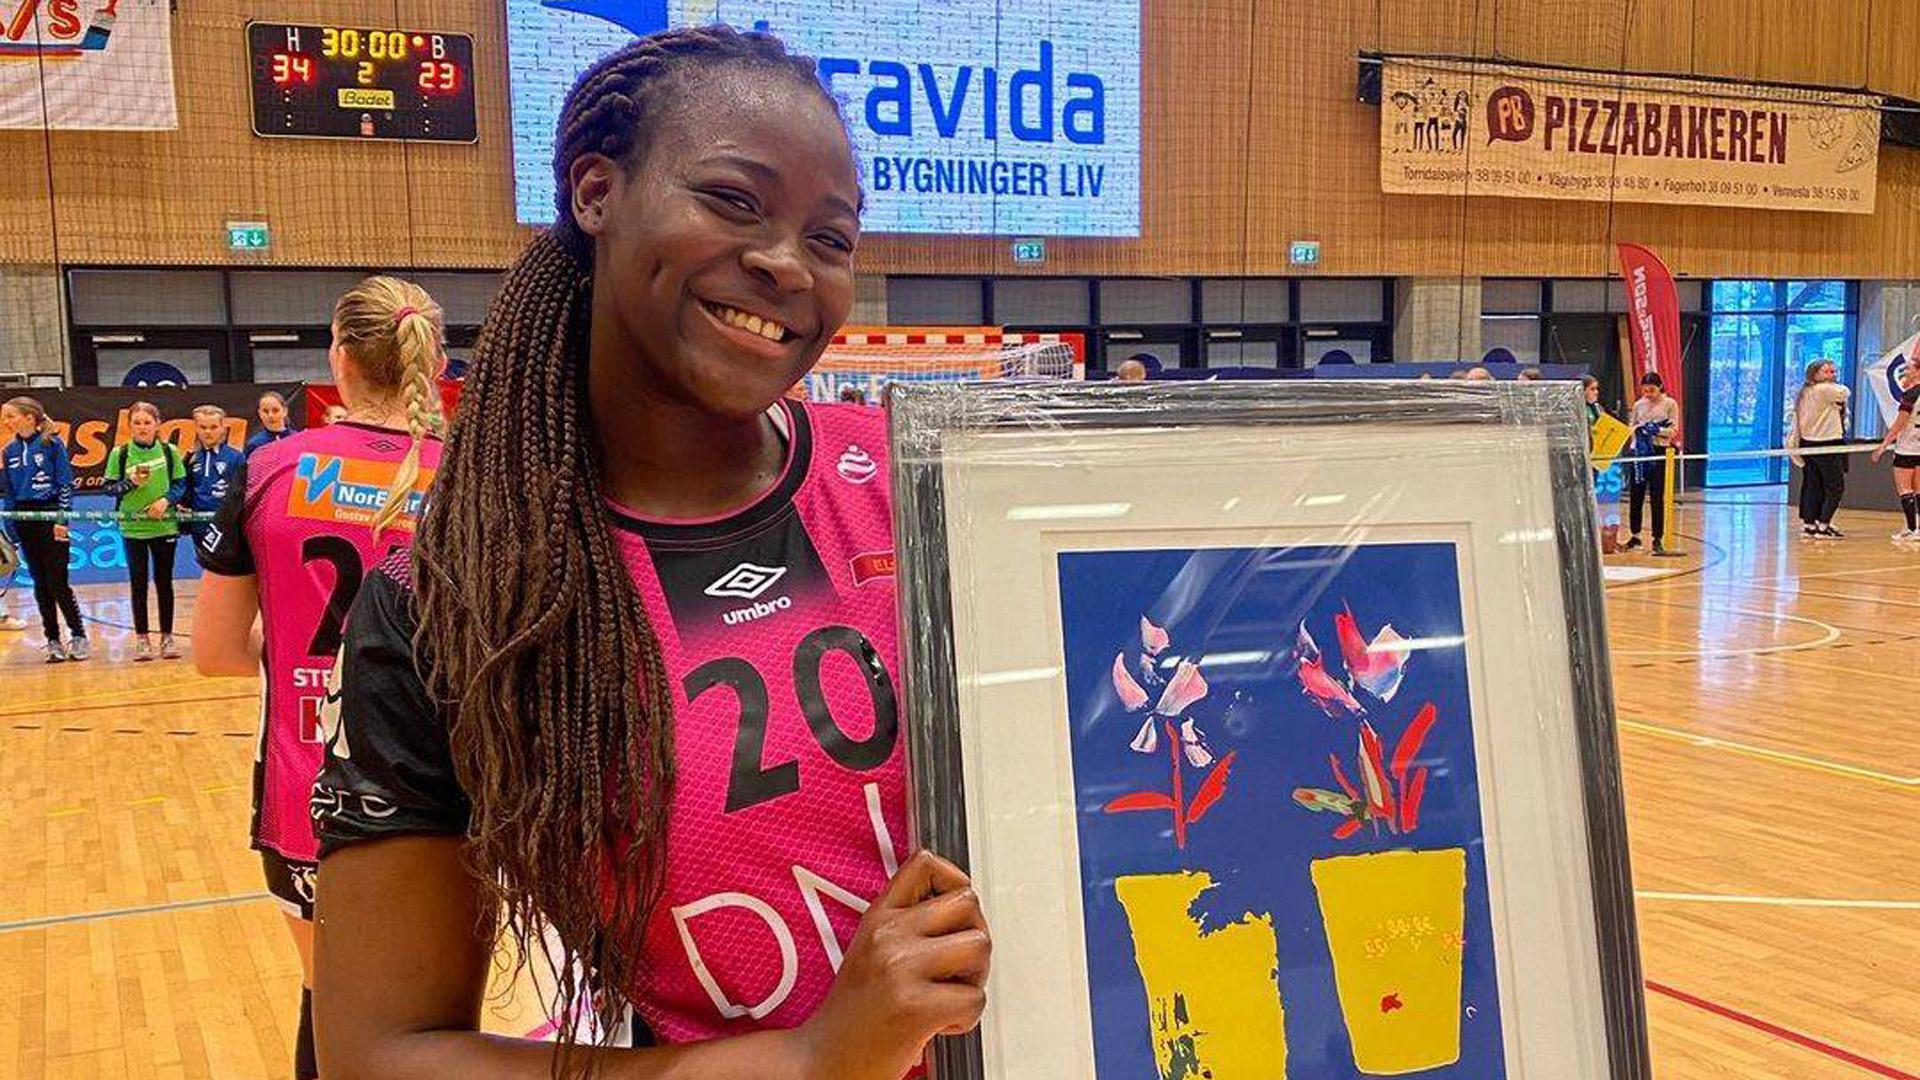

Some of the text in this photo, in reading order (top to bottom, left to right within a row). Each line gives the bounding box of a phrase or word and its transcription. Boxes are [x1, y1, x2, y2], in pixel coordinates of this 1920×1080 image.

[286, 27, 301, 52] H
[322, 28, 407, 59] 30:00
[431, 34, 446, 60] B
[272, 54, 310, 83] 34
[356, 61, 375, 84] 2
[418, 62, 455, 89] 23
[1499, 94, 1788, 165] PB PIZZABAKEREN
[873, 156, 1105, 198] BYGNINGER LIV
[723, 595, 792, 626] umbro
[681, 624, 899, 815] 20
